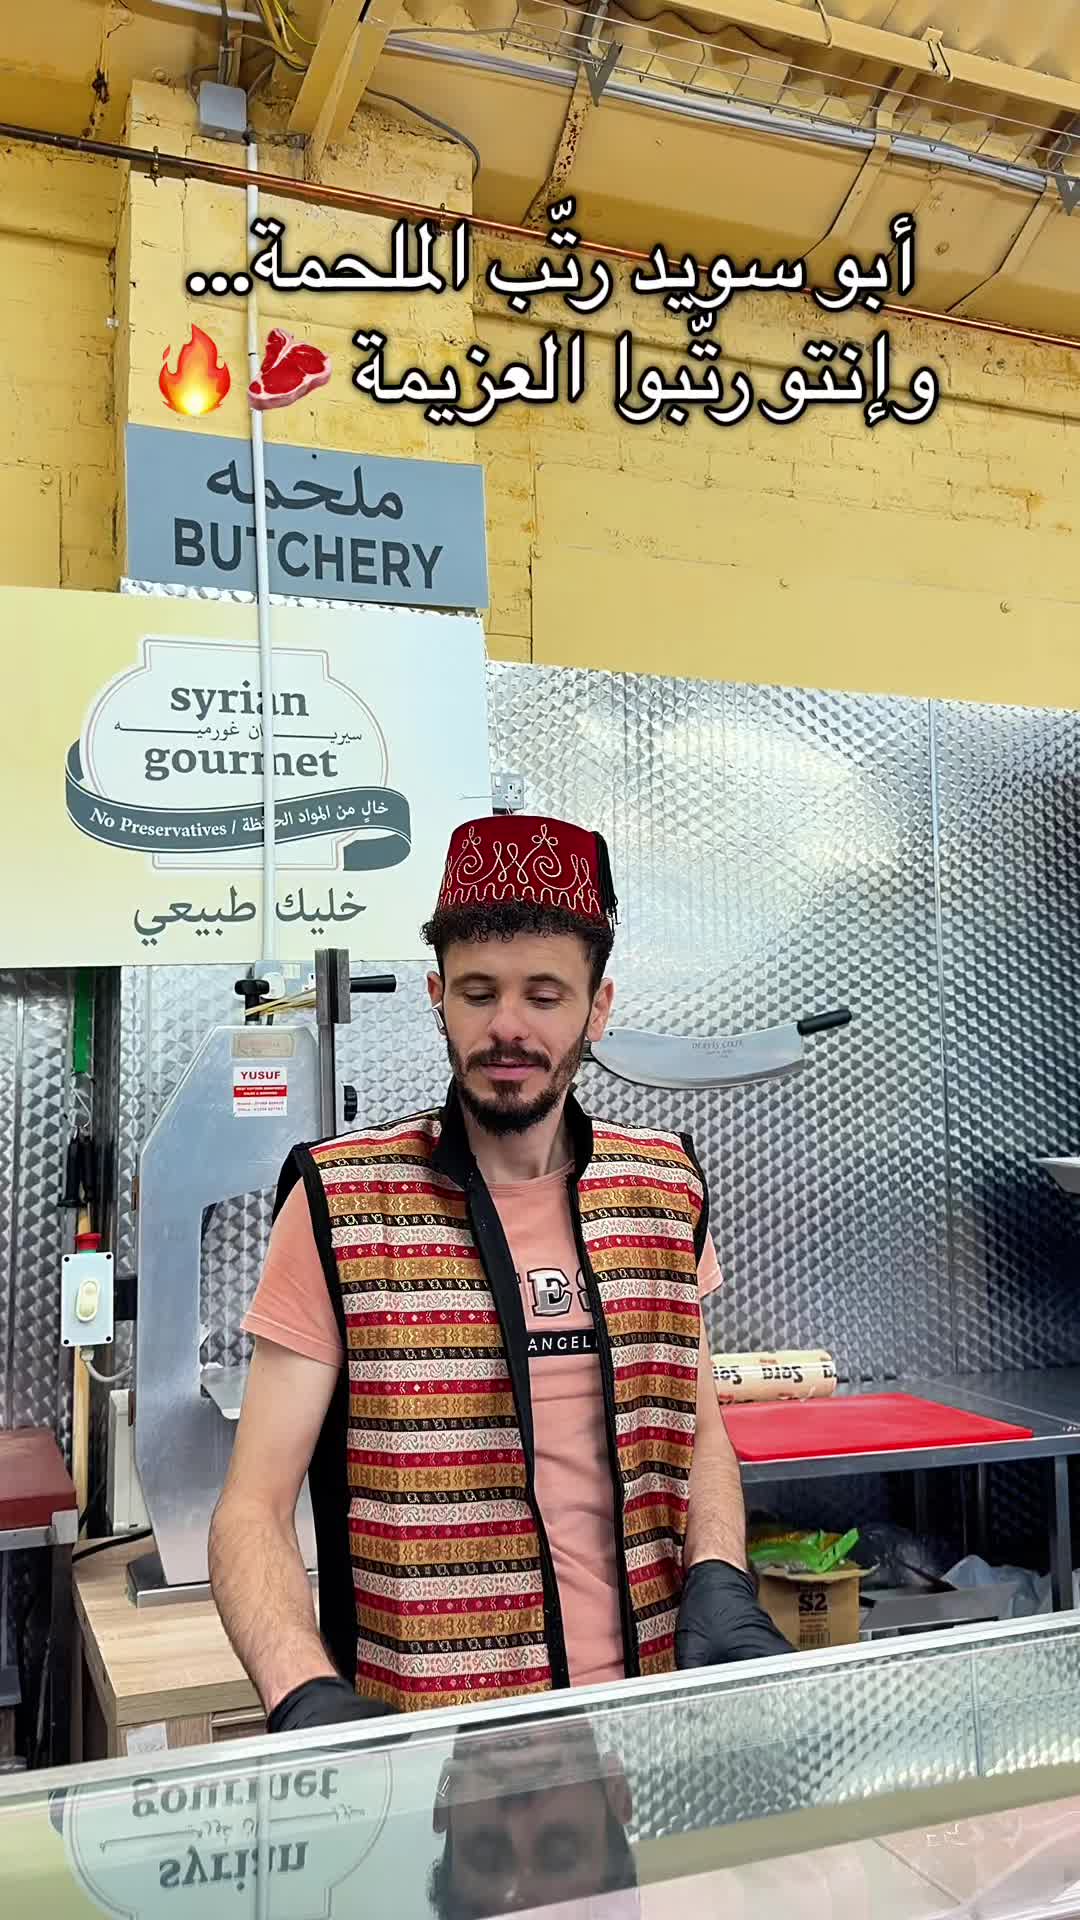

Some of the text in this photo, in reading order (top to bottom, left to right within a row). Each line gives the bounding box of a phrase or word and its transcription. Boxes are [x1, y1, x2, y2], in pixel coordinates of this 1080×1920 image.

[169, 679, 310, 720] syrian
[143, 746, 339, 782] gourmet
[88, 806, 116, 829] No
[118, 815, 228, 838] Preservatives
[298, 804, 332, 825] المواد
[335, 805, 356, 820] من
[133, 886, 368, 947] خليك طبيعي
[240, 1070, 281, 1080] YUSUF
[527, 1335, 598, 1352] ANGEL
[798, 1592, 828, 1612] S2
